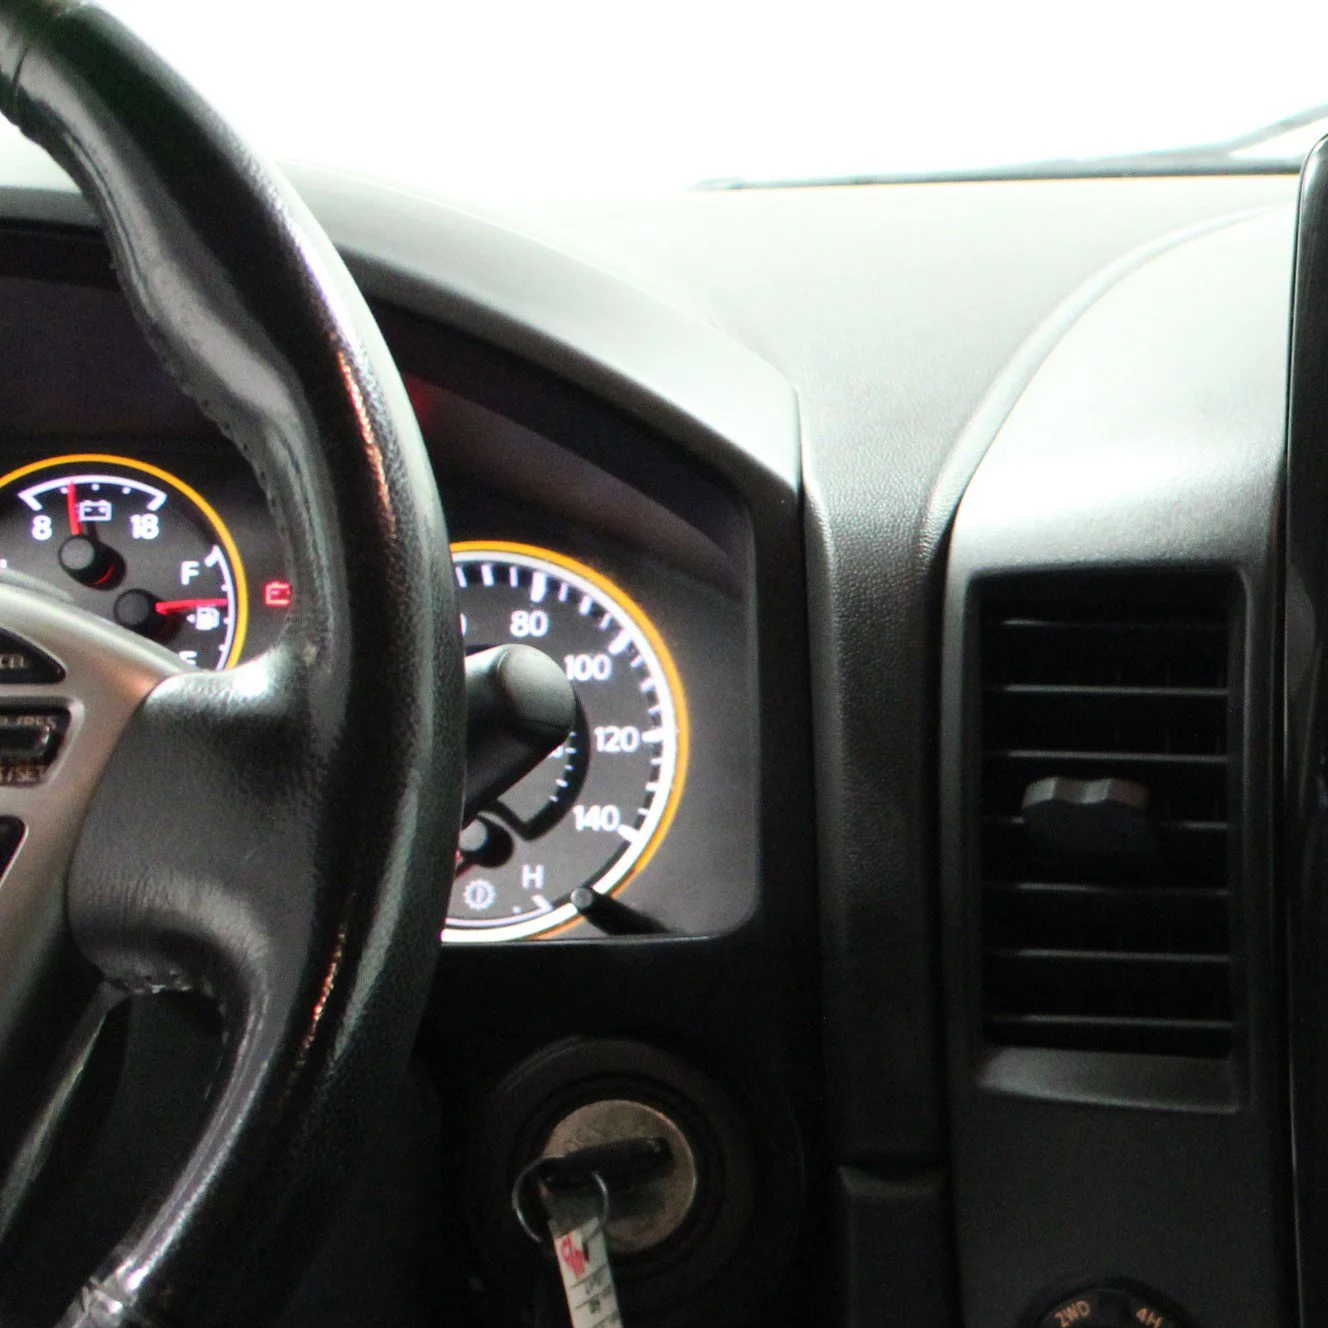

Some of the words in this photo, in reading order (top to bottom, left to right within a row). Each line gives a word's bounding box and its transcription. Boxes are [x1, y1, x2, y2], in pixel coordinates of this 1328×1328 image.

[31, 514, 53, 540] 8
[131, 513, 160, 540] 18
[180, 560, 200, 585] F
[510, 611, 548, 637] 80
[564, 653, 612, 681] 100
[594, 727, 640, 752] 120
[573, 804, 622, 832] 140
[522, 864, 544, 889] H
[1055, 1300, 1091, 1328] 2WD
